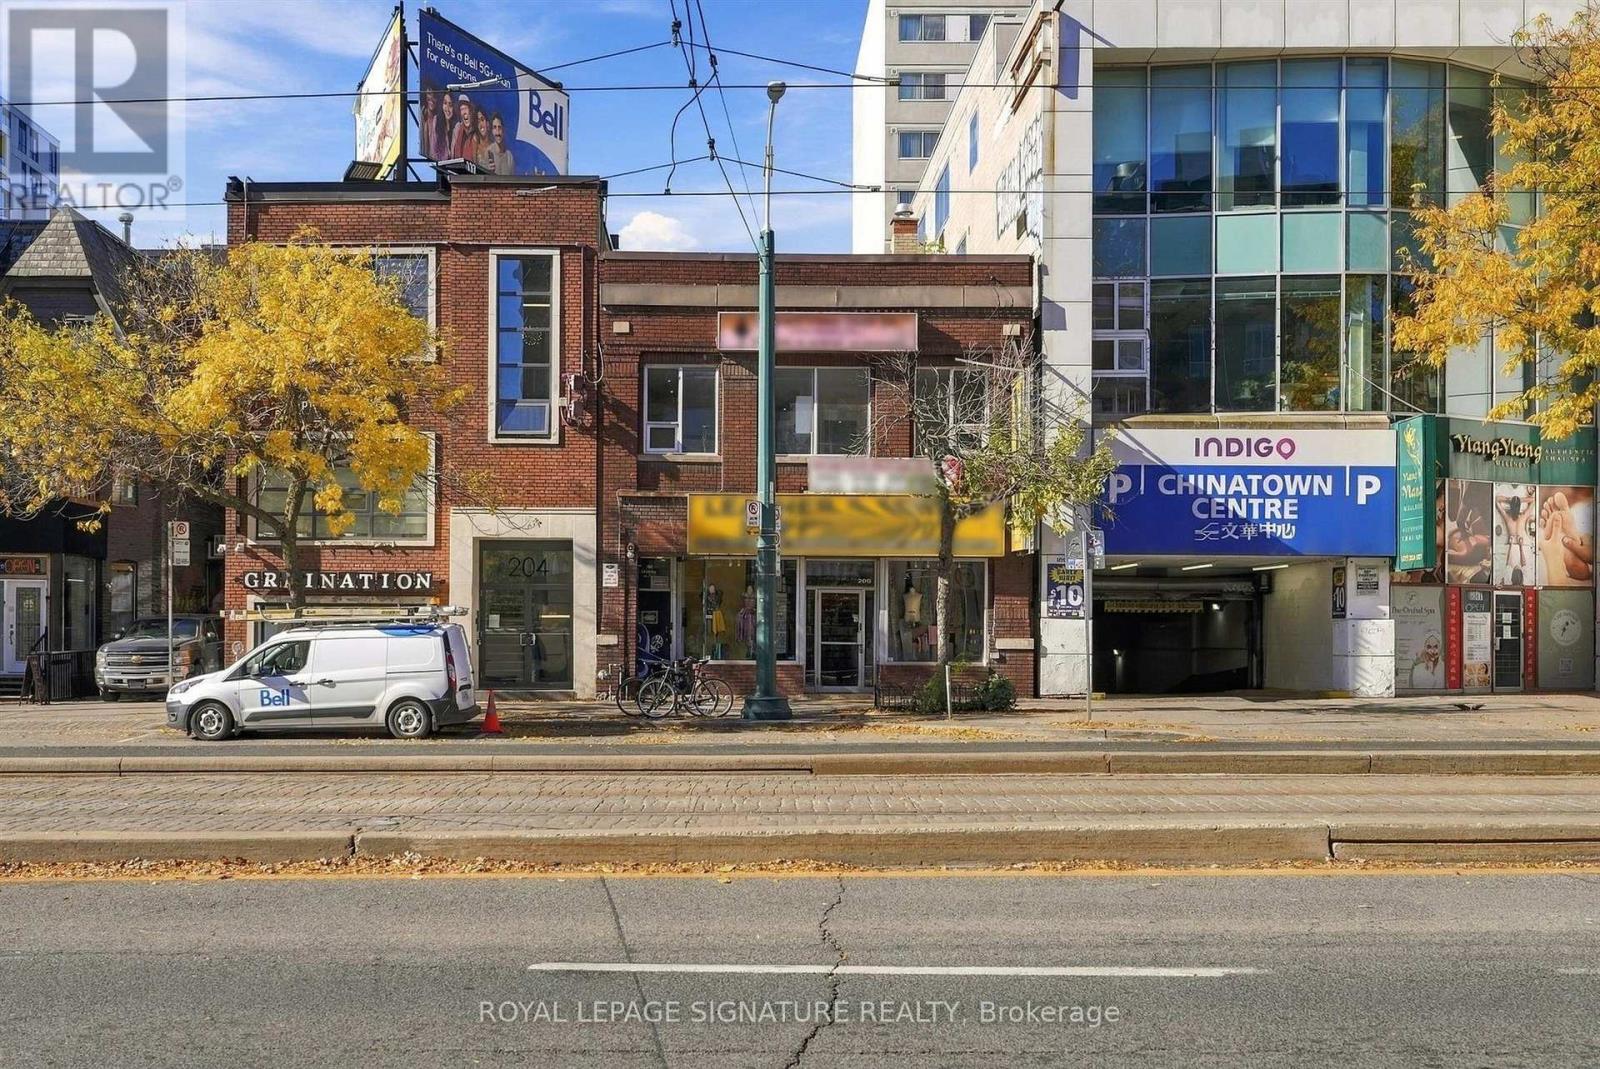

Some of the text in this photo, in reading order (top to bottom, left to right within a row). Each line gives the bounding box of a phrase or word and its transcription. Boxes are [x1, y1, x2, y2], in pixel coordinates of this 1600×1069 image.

[426, 31, 456, 58] There's
[464, 53, 478, 71] Bell
[426, 47, 439, 63] for
[528, 87, 564, 141] Bell
[1194, 437, 1296, 460] INDIGO
[1109, 472, 1132, 504] P
[1157, 473, 1333, 496] CHINATOWN
[1357, 475, 1381, 505] P
[1191, 497, 1299, 520] CENTRE
[1221, 521, 1296, 541] 文華中心
[508, 556, 550, 578] 204
[260, 688, 290, 707] Bell
